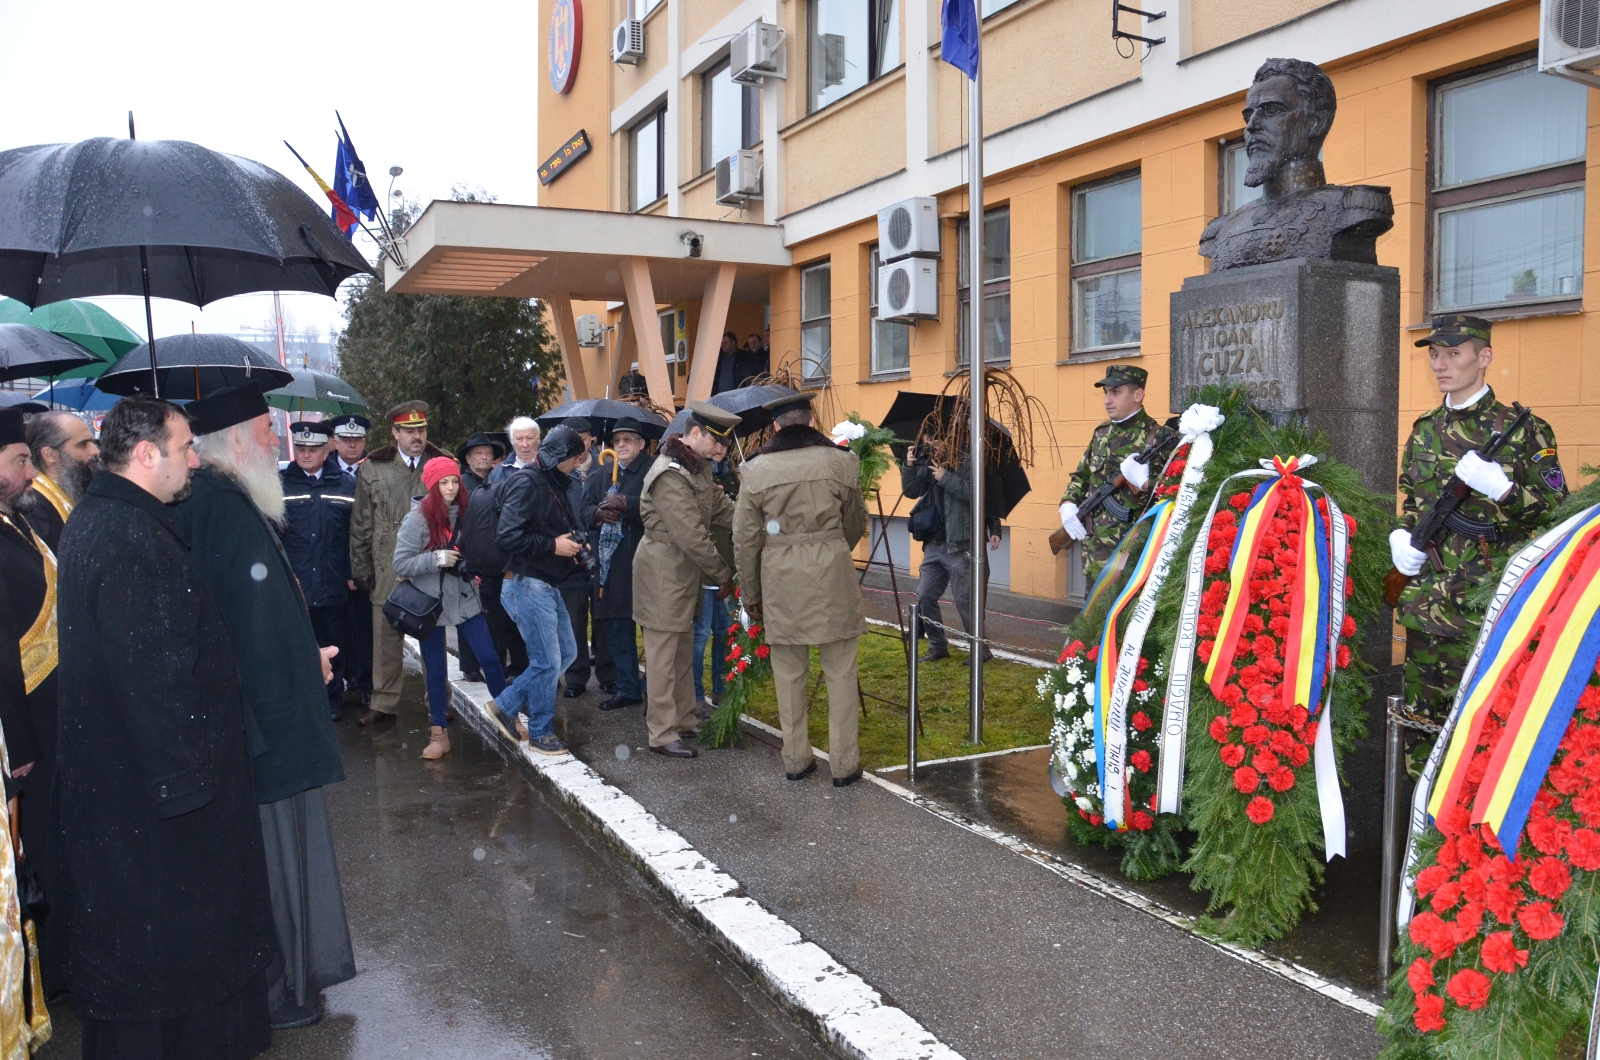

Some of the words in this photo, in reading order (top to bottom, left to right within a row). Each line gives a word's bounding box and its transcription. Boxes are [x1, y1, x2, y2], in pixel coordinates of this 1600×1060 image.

[1181, 299, 1285, 331] ALEXANDRU
[1207, 327, 1252, 348] IOAN
[1200, 350, 1262, 377] CUZA
[1124, 643, 1135, 657] AL
[1167, 673, 1186, 736] OMAGIU
[1179, 589, 1199, 649] EROILOR
